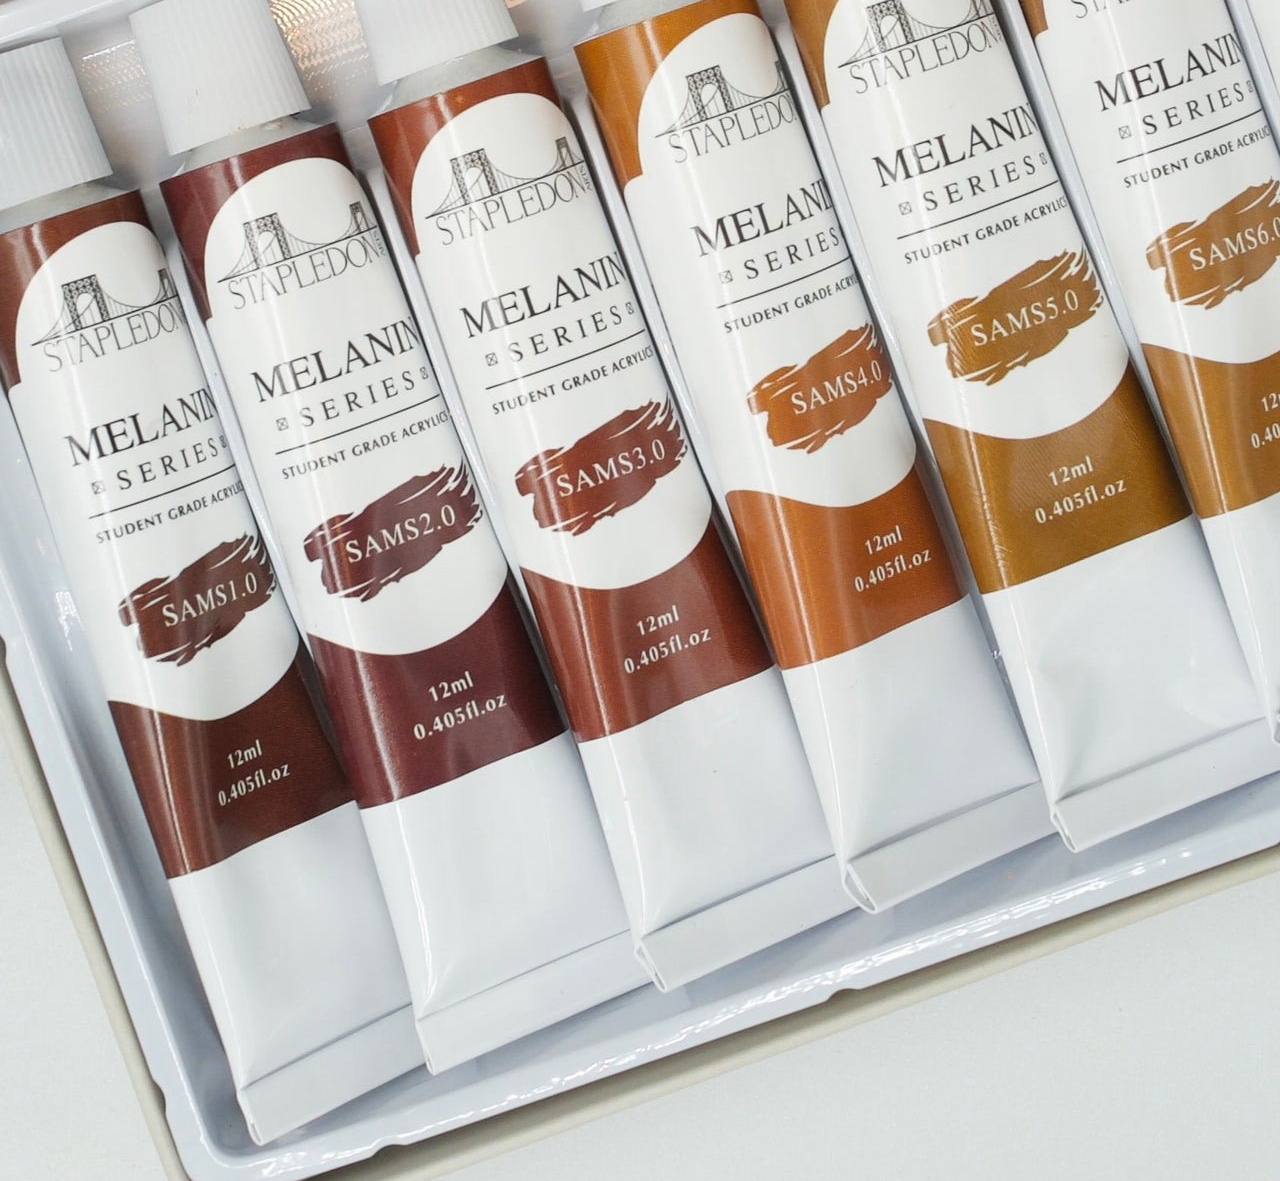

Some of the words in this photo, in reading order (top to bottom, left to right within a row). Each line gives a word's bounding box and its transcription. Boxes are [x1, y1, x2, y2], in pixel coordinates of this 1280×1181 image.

[849, 20, 999, 95] STAPLEDON
[1142, 82, 1245, 135] SERIES
[922, 155, 1036, 212] SERIES
[1123, 157, 1189, 189] STUDENT
[1193, 140, 1235, 165] GRADE
[435, 170, 586, 246] STAPLEDON
[743, 227, 839, 280] SERIES
[904, 233, 970, 265] STUDENT
[975, 215, 1020, 241] GRADE
[227, 235, 380, 310] STAPLEDON
[459, 251, 626, 339] MELANIN
[511, 305, 622, 362] SERIES
[723, 301, 790, 334] STUDENT
[794, 284, 833, 309] GRADE
[970, 289, 1079, 347] SAMS5.0
[250, 316, 420, 403] MELANIN
[302, 370, 415, 427] SERIES
[491, 383, 556, 415] STUDENT
[561, 365, 609, 391] GRADE
[790, 359, 882, 415] SAMS4.0
[116, 437, 219, 491] SERIES
[281, 449, 346, 480] STUDENT
[351, 431, 398, 457] GRADE
[556, 439, 666, 498] SAMS3.0
[1048, 455, 1094, 486] 12ml
[96, 512, 163, 542] STUDENT
[167, 496, 209, 521] GRADE
[1034, 479, 1127, 524] 0.405fl.oz
[345, 504, 456, 564] SAMS2.0
[864, 524, 903, 555] 12ml
[854, 549, 932, 592] 0.405fl.oz
[161, 571, 258, 628] SAMS1.0
[636, 604, 680, 636] 12ml
[624, 628, 711, 674] 0.405fl.oz
[428, 670, 474, 702] 12ml
[413, 694, 507, 740] 0.405fl.oz
[227, 739, 263, 769] 12ml
[218, 764, 291, 806] 0.405fl.oz
